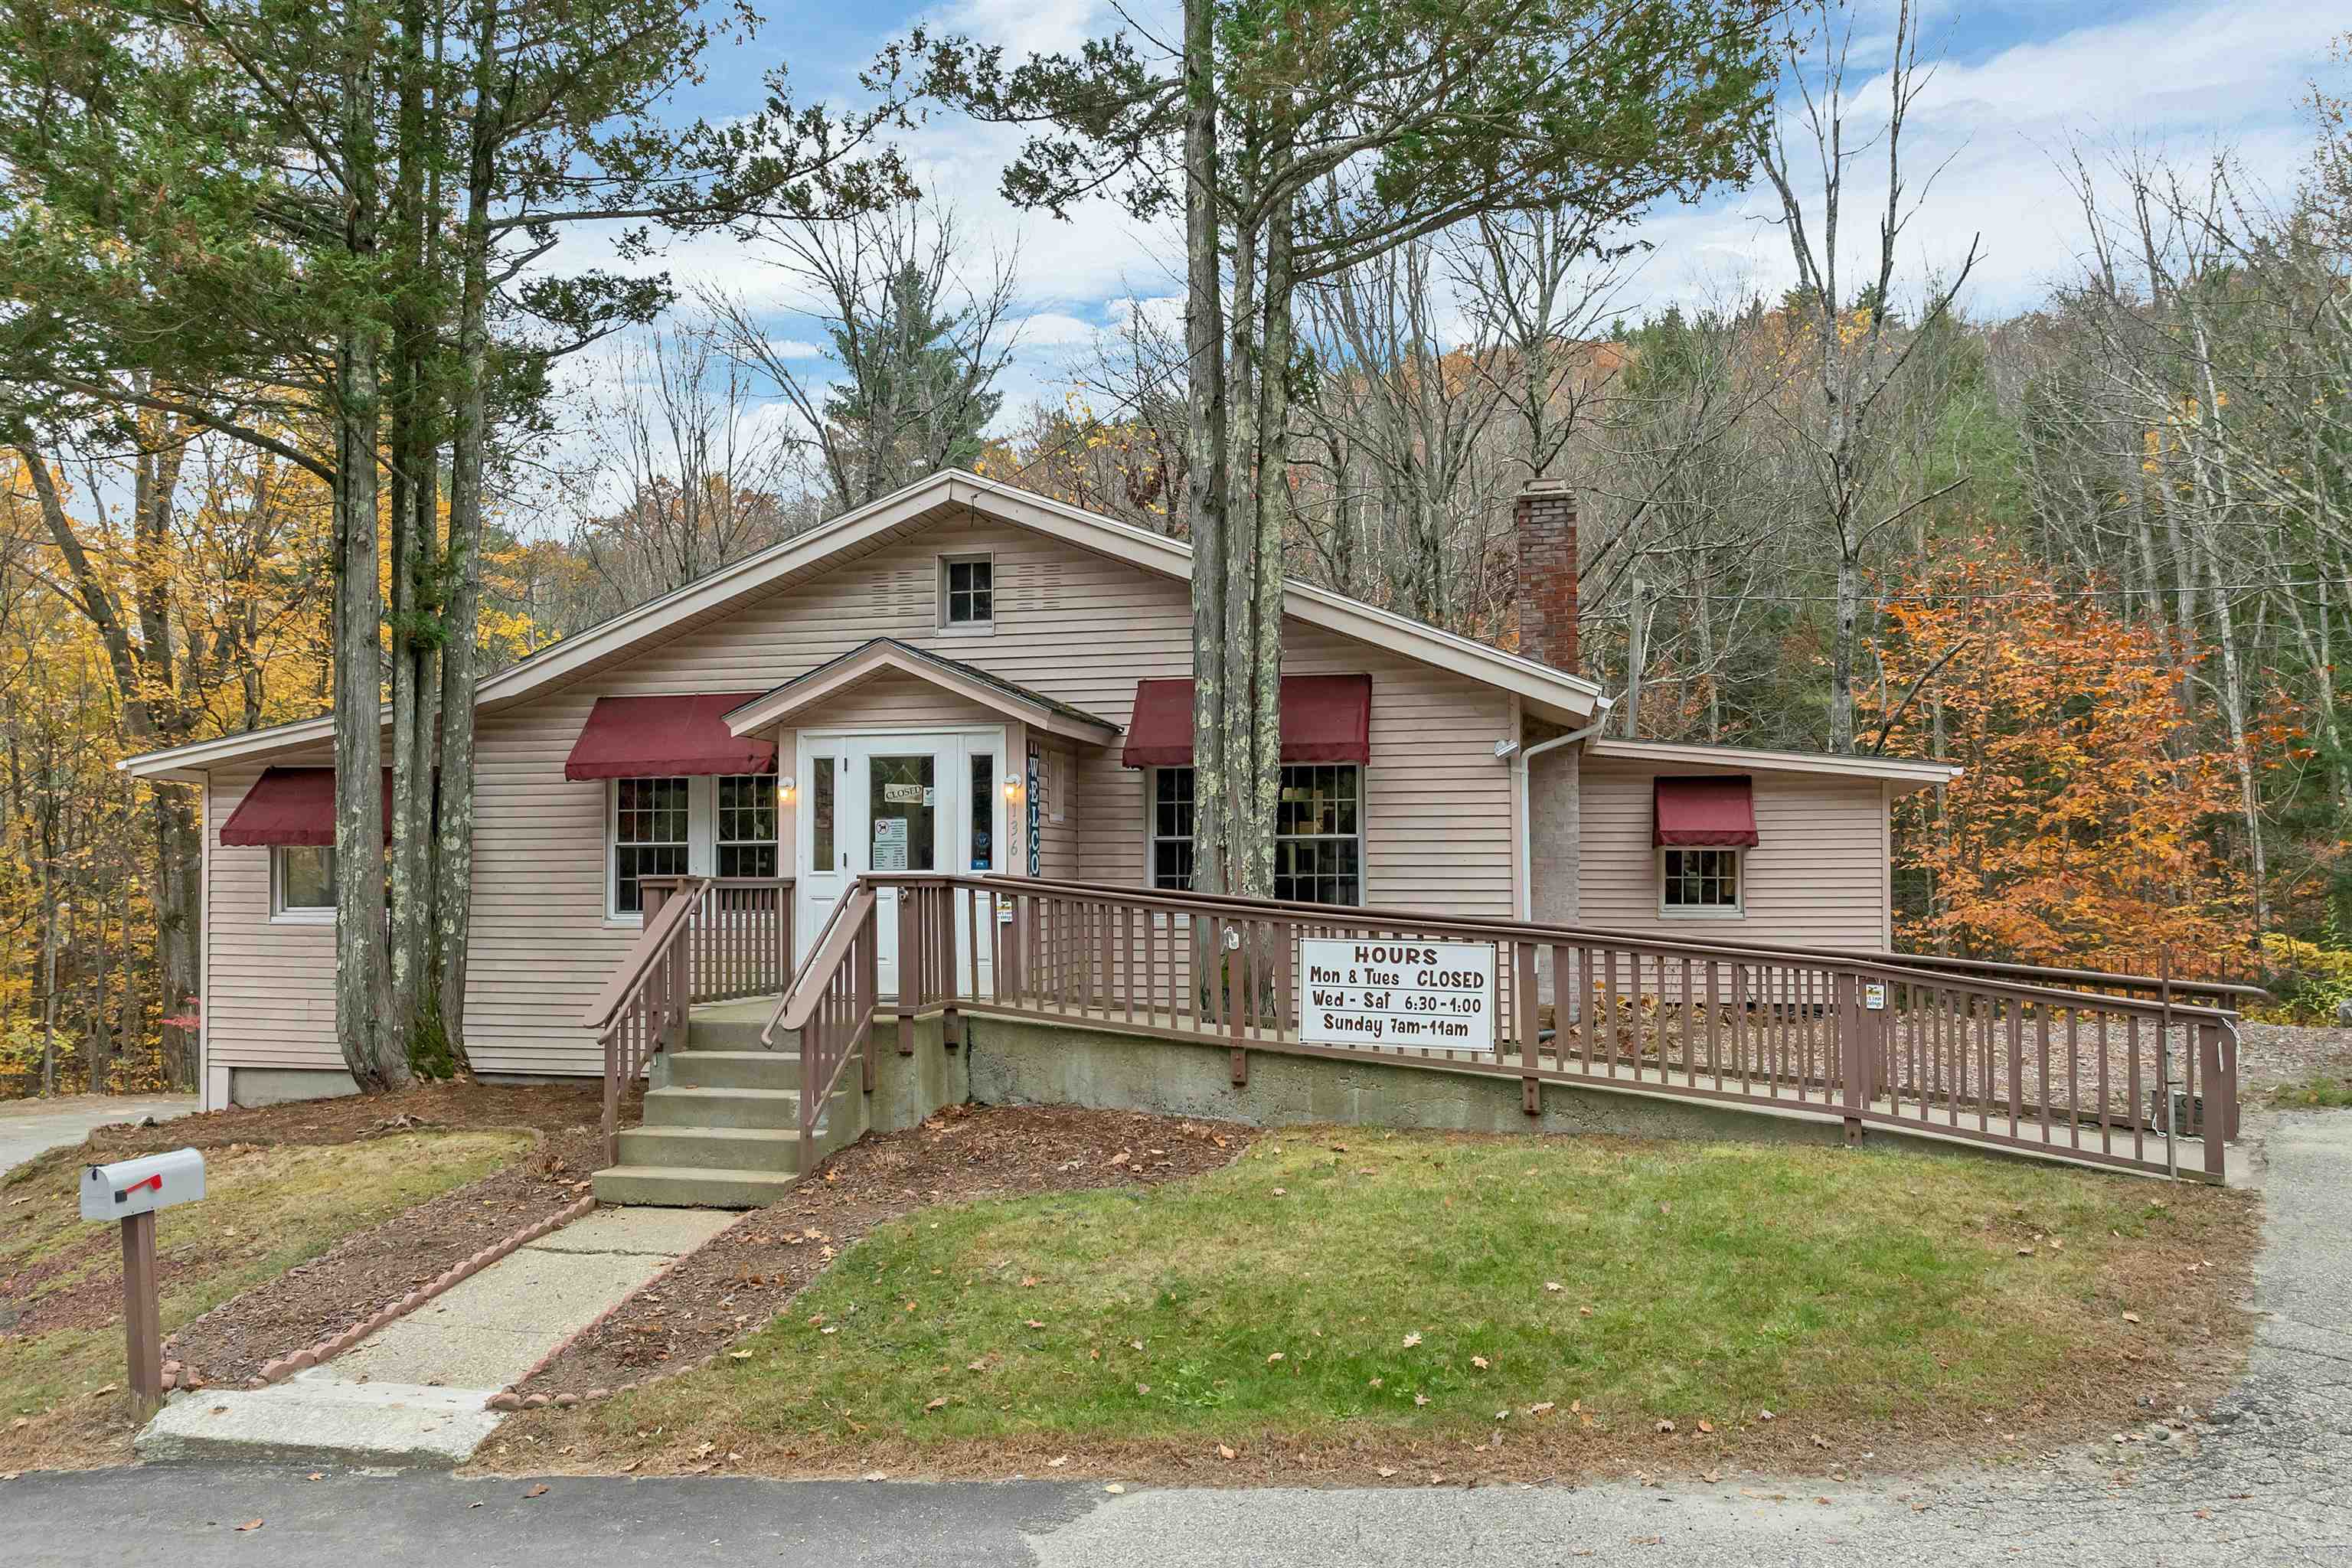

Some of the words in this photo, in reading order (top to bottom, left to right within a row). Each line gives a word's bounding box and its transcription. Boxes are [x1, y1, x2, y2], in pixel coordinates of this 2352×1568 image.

[886, 786, 922, 799] CLOSED
[1029, 756, 1040, 874] WELCO
[1354, 946, 1439, 965] HOURS
[1310, 966, 1341, 984] Mon
[1348, 969, 1358, 984] &
[1364, 968, 1400, 985] Tues
[1416, 969, 1485, 988] CLOSED
[1312, 989, 1344, 1007] Wed
[1363, 991, 1391, 1009] Sat
[1323, 1013, 1383, 1038] Sunday
[1390, 1018, 1468, 1037] 7am-11am
